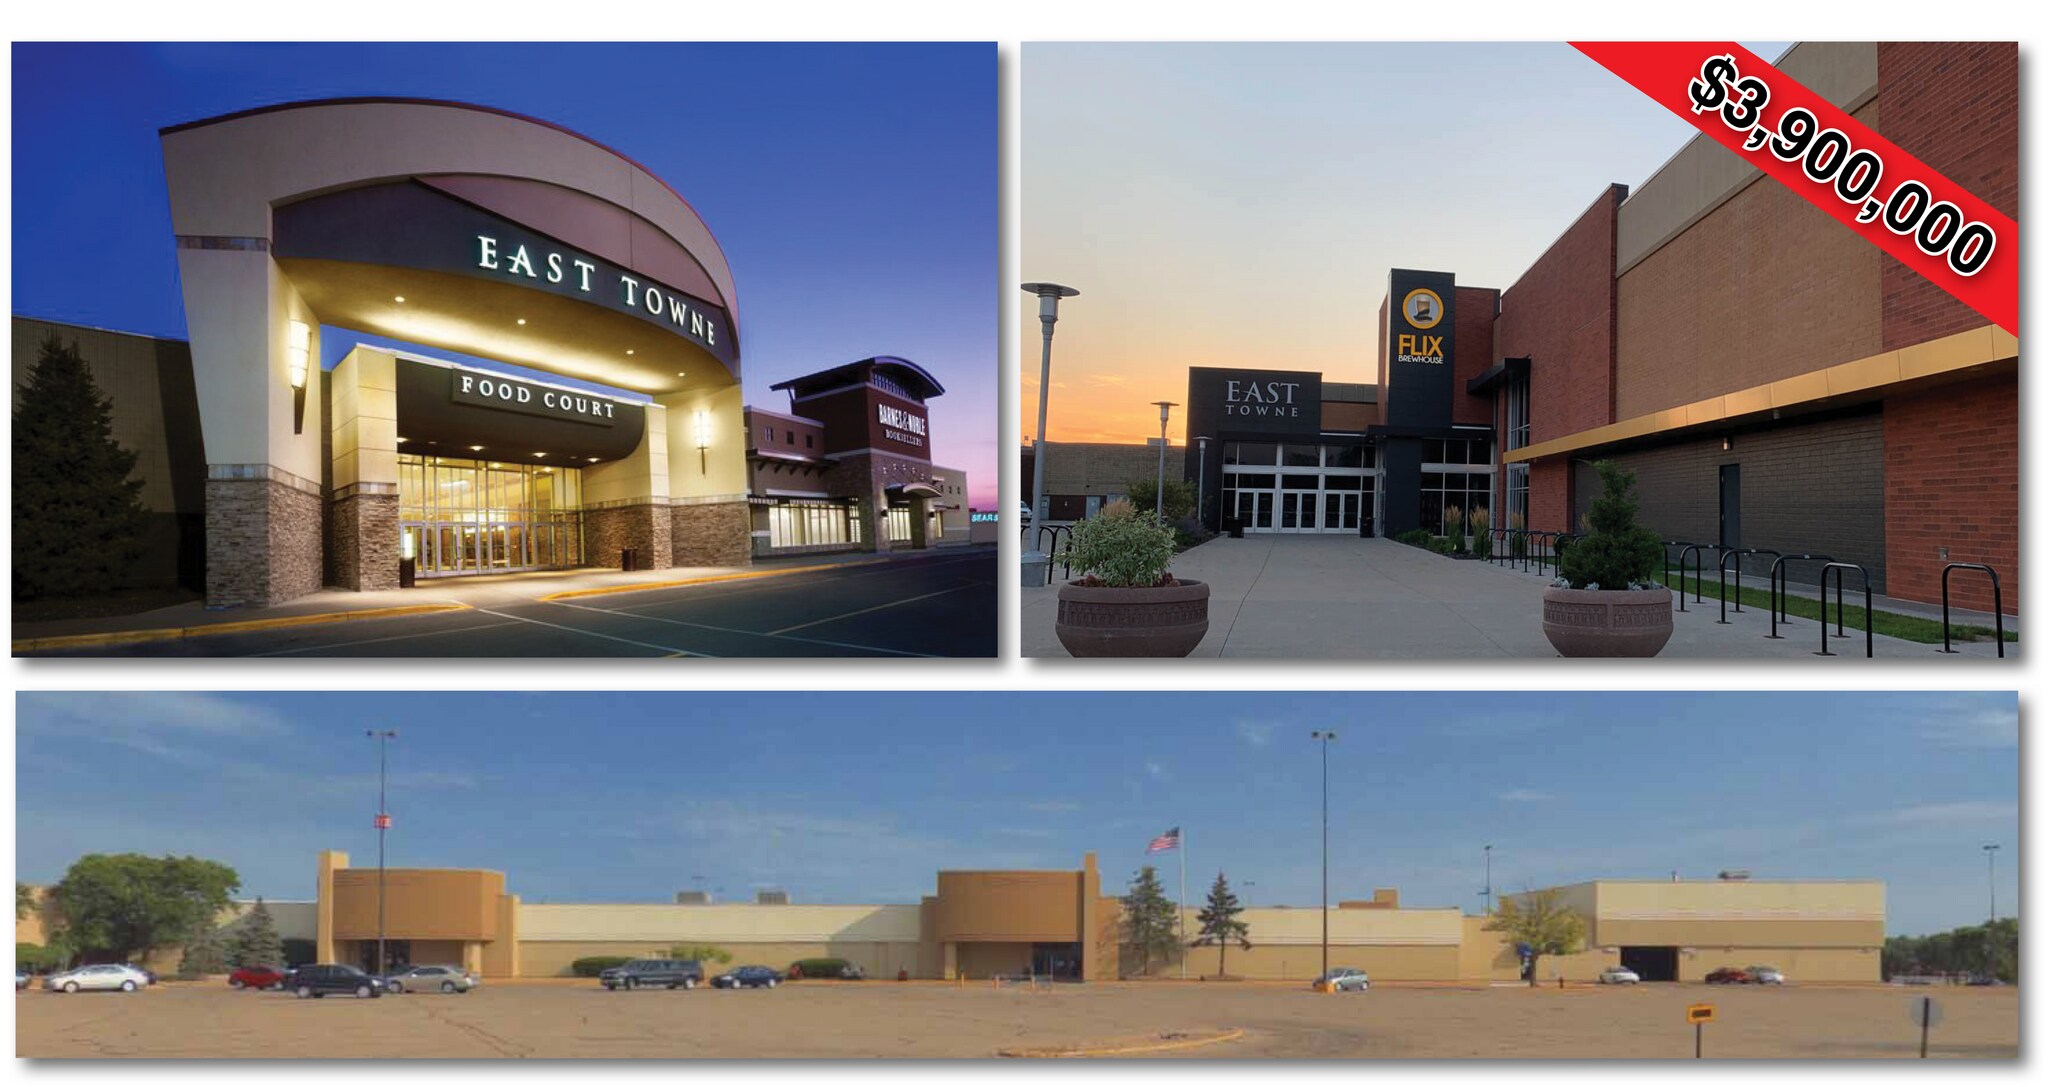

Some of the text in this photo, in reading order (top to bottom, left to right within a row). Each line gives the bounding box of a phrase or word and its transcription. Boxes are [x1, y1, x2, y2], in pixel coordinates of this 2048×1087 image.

[477, 236, 715, 345] EAST TOWNE
[1398, 334, 1443, 357] FLIX
[1398, 355, 1443, 364] BREWHOUSE
[461, 376, 615, 418] FOOD COURT
[1225, 381, 1299, 404] EAST
[1225, 405, 1298, 417] TOWNE
[885, 429, 922, 446] BOOKSELLERS
[971, 513, 998, 523] SEARS
